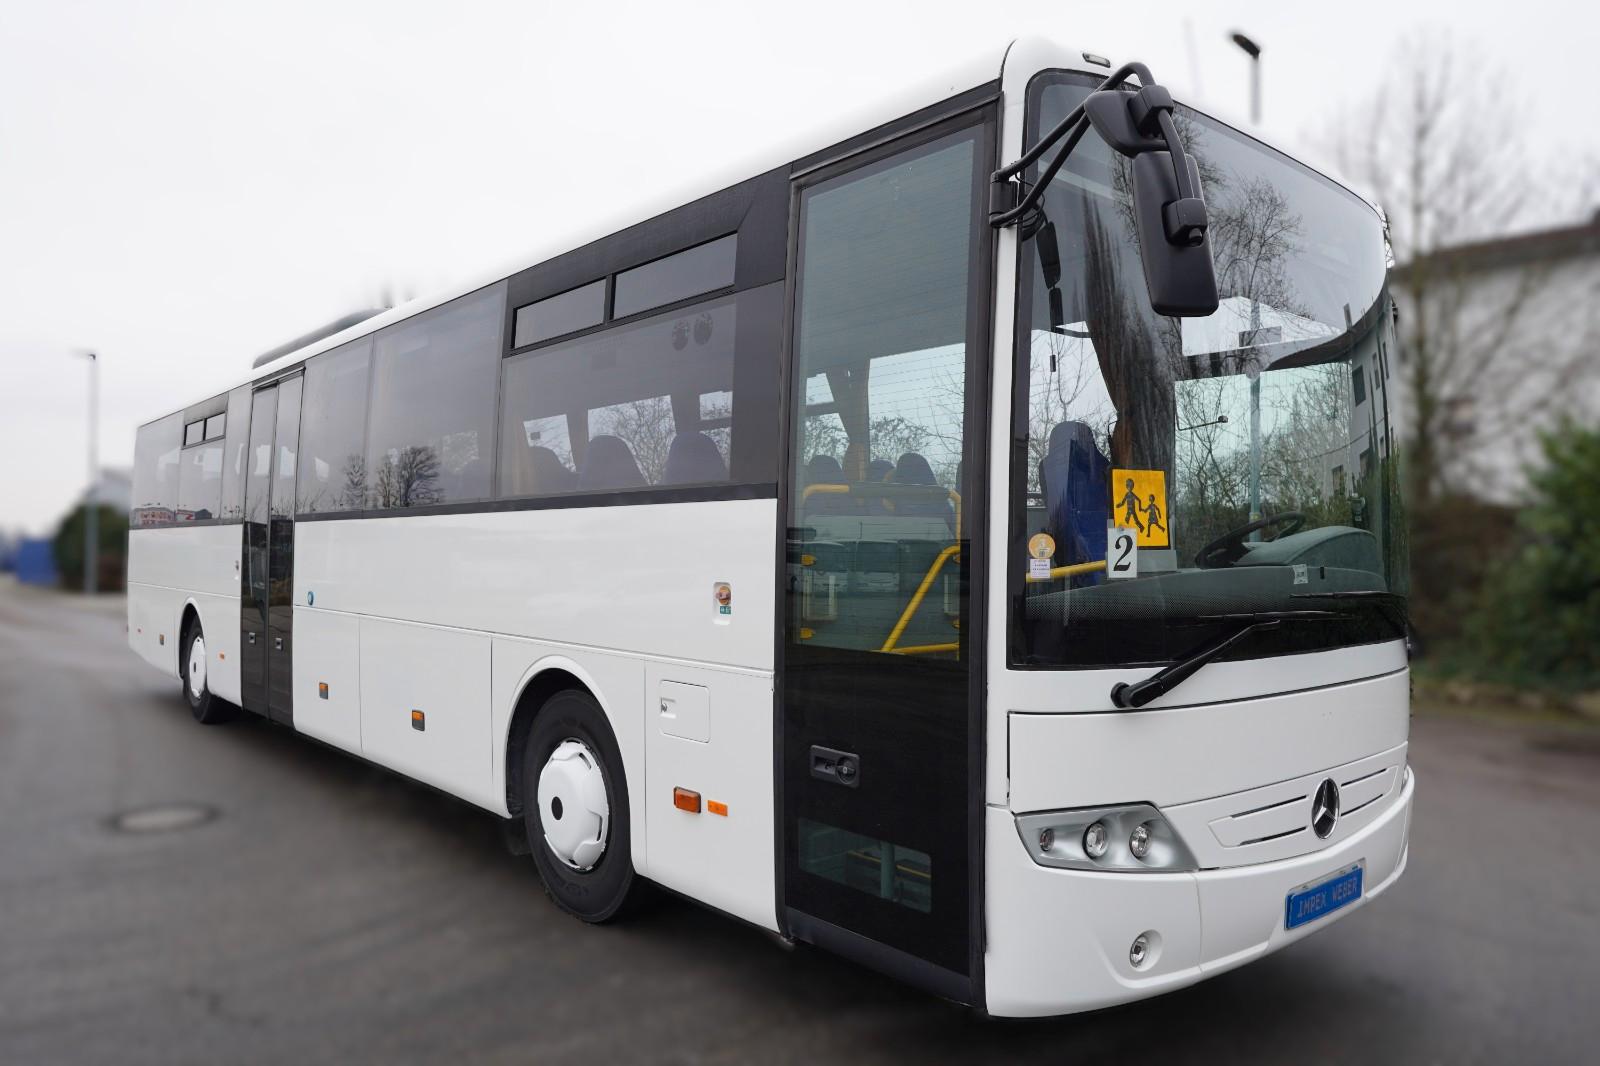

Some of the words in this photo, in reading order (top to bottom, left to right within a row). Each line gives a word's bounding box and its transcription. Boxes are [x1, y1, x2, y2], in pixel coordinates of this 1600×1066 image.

[1114, 535, 1133, 572] 2
[1297, 891, 1327, 918] IMPEX
[1332, 876, 1357, 903] WEBER
